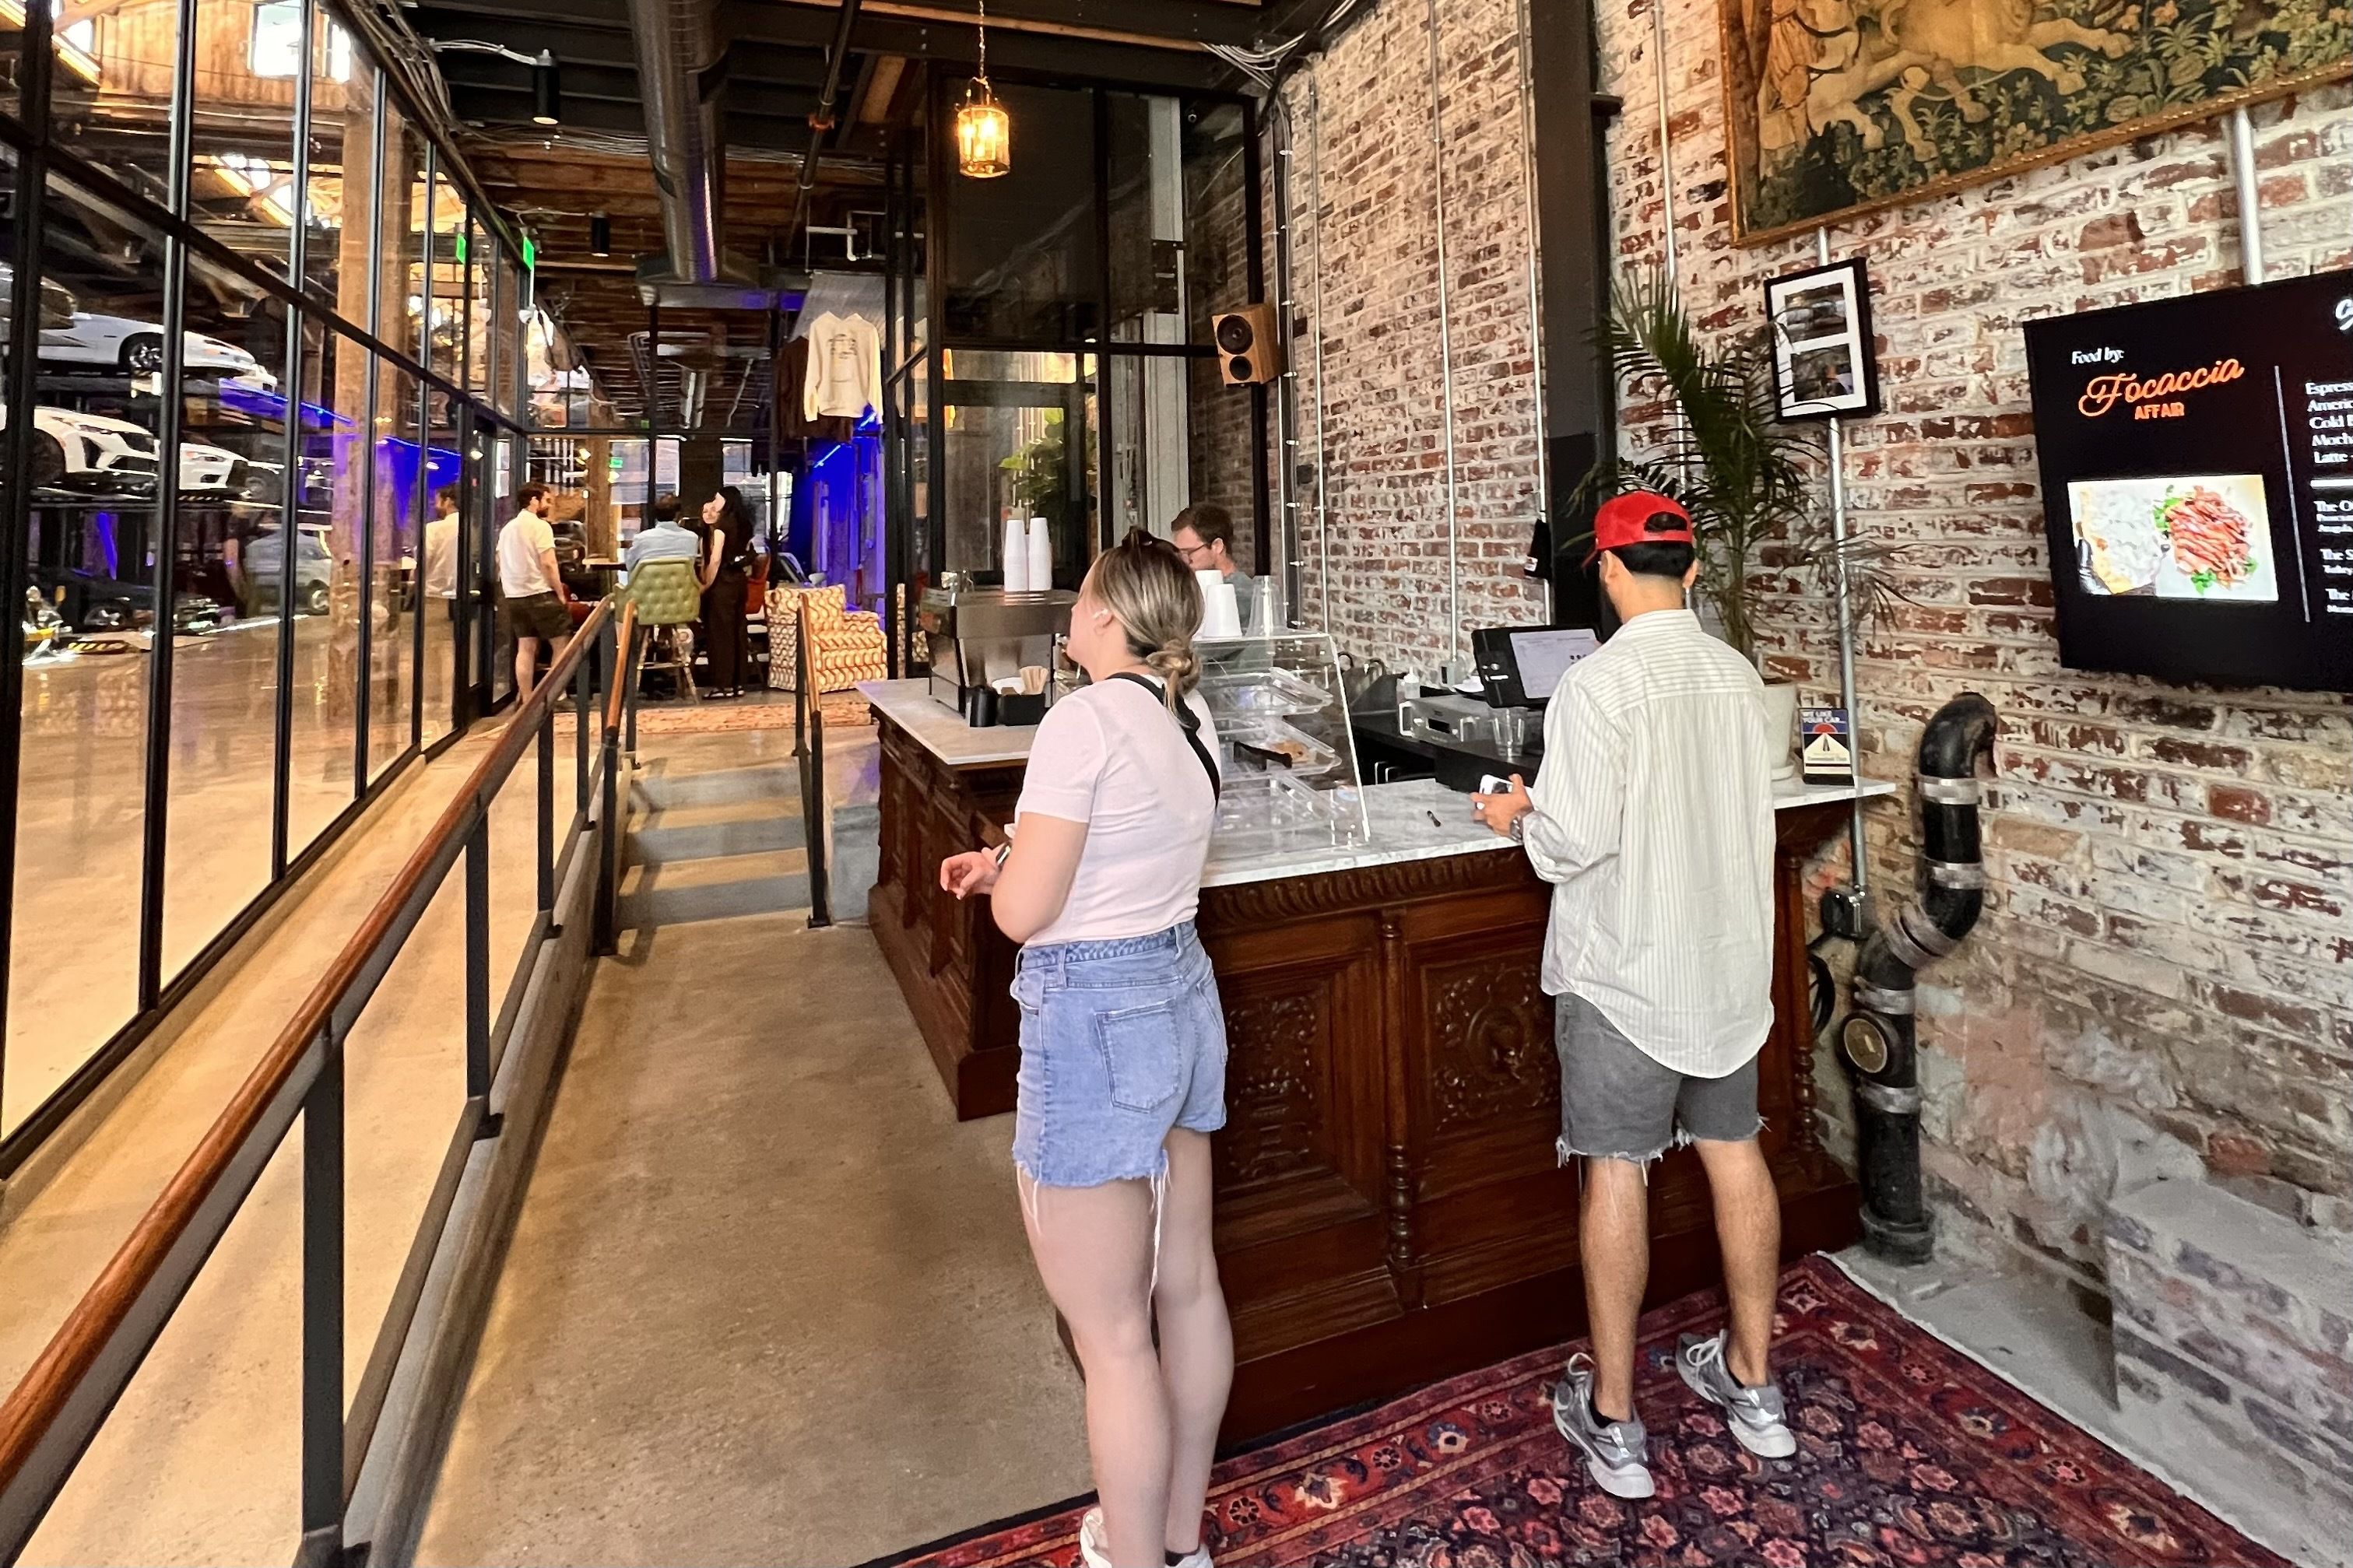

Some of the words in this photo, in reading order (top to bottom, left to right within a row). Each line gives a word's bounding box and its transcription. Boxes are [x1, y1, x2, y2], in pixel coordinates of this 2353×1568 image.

[2071, 348, 2102, 365] Food
[2104, 346, 2125, 363] by:
[2077, 358, 2246, 417] Focaccia
[2134, 402, 2185, 420] AFFAIR
[2309, 415, 2345, 429] Cold
[2313, 500, 2338, 512] The
[2320, 549, 2344, 559] The
